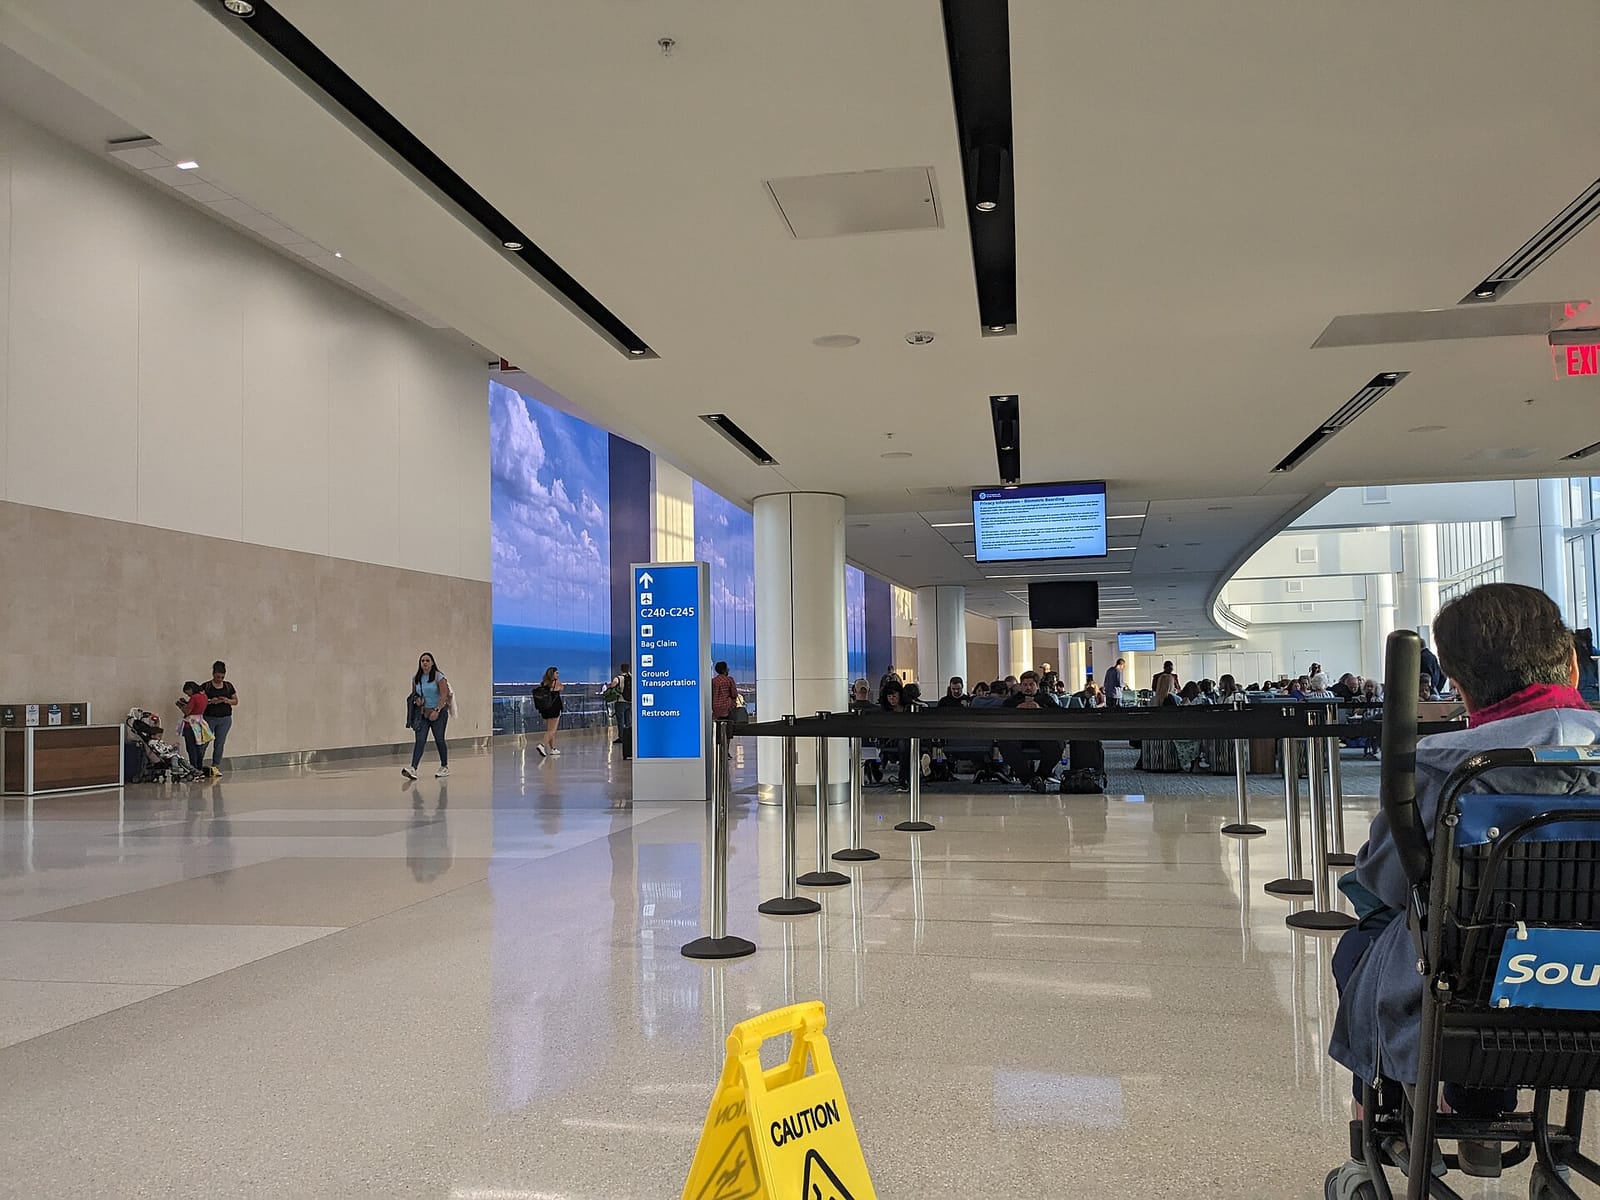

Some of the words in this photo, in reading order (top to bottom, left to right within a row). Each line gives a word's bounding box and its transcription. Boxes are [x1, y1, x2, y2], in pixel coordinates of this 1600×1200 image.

[1566, 345, 1600, 376] EXI
[640, 607, 695, 618] C240-C245
[641, 640, 655, 649] Bag
[656, 640, 678, 648] Claim
[641, 670, 670, 678] Ground
[641, 679, 697, 688] Transportation
[641, 709, 680, 717] Restrooms
[770, 1099, 841, 1147] CAUTION
